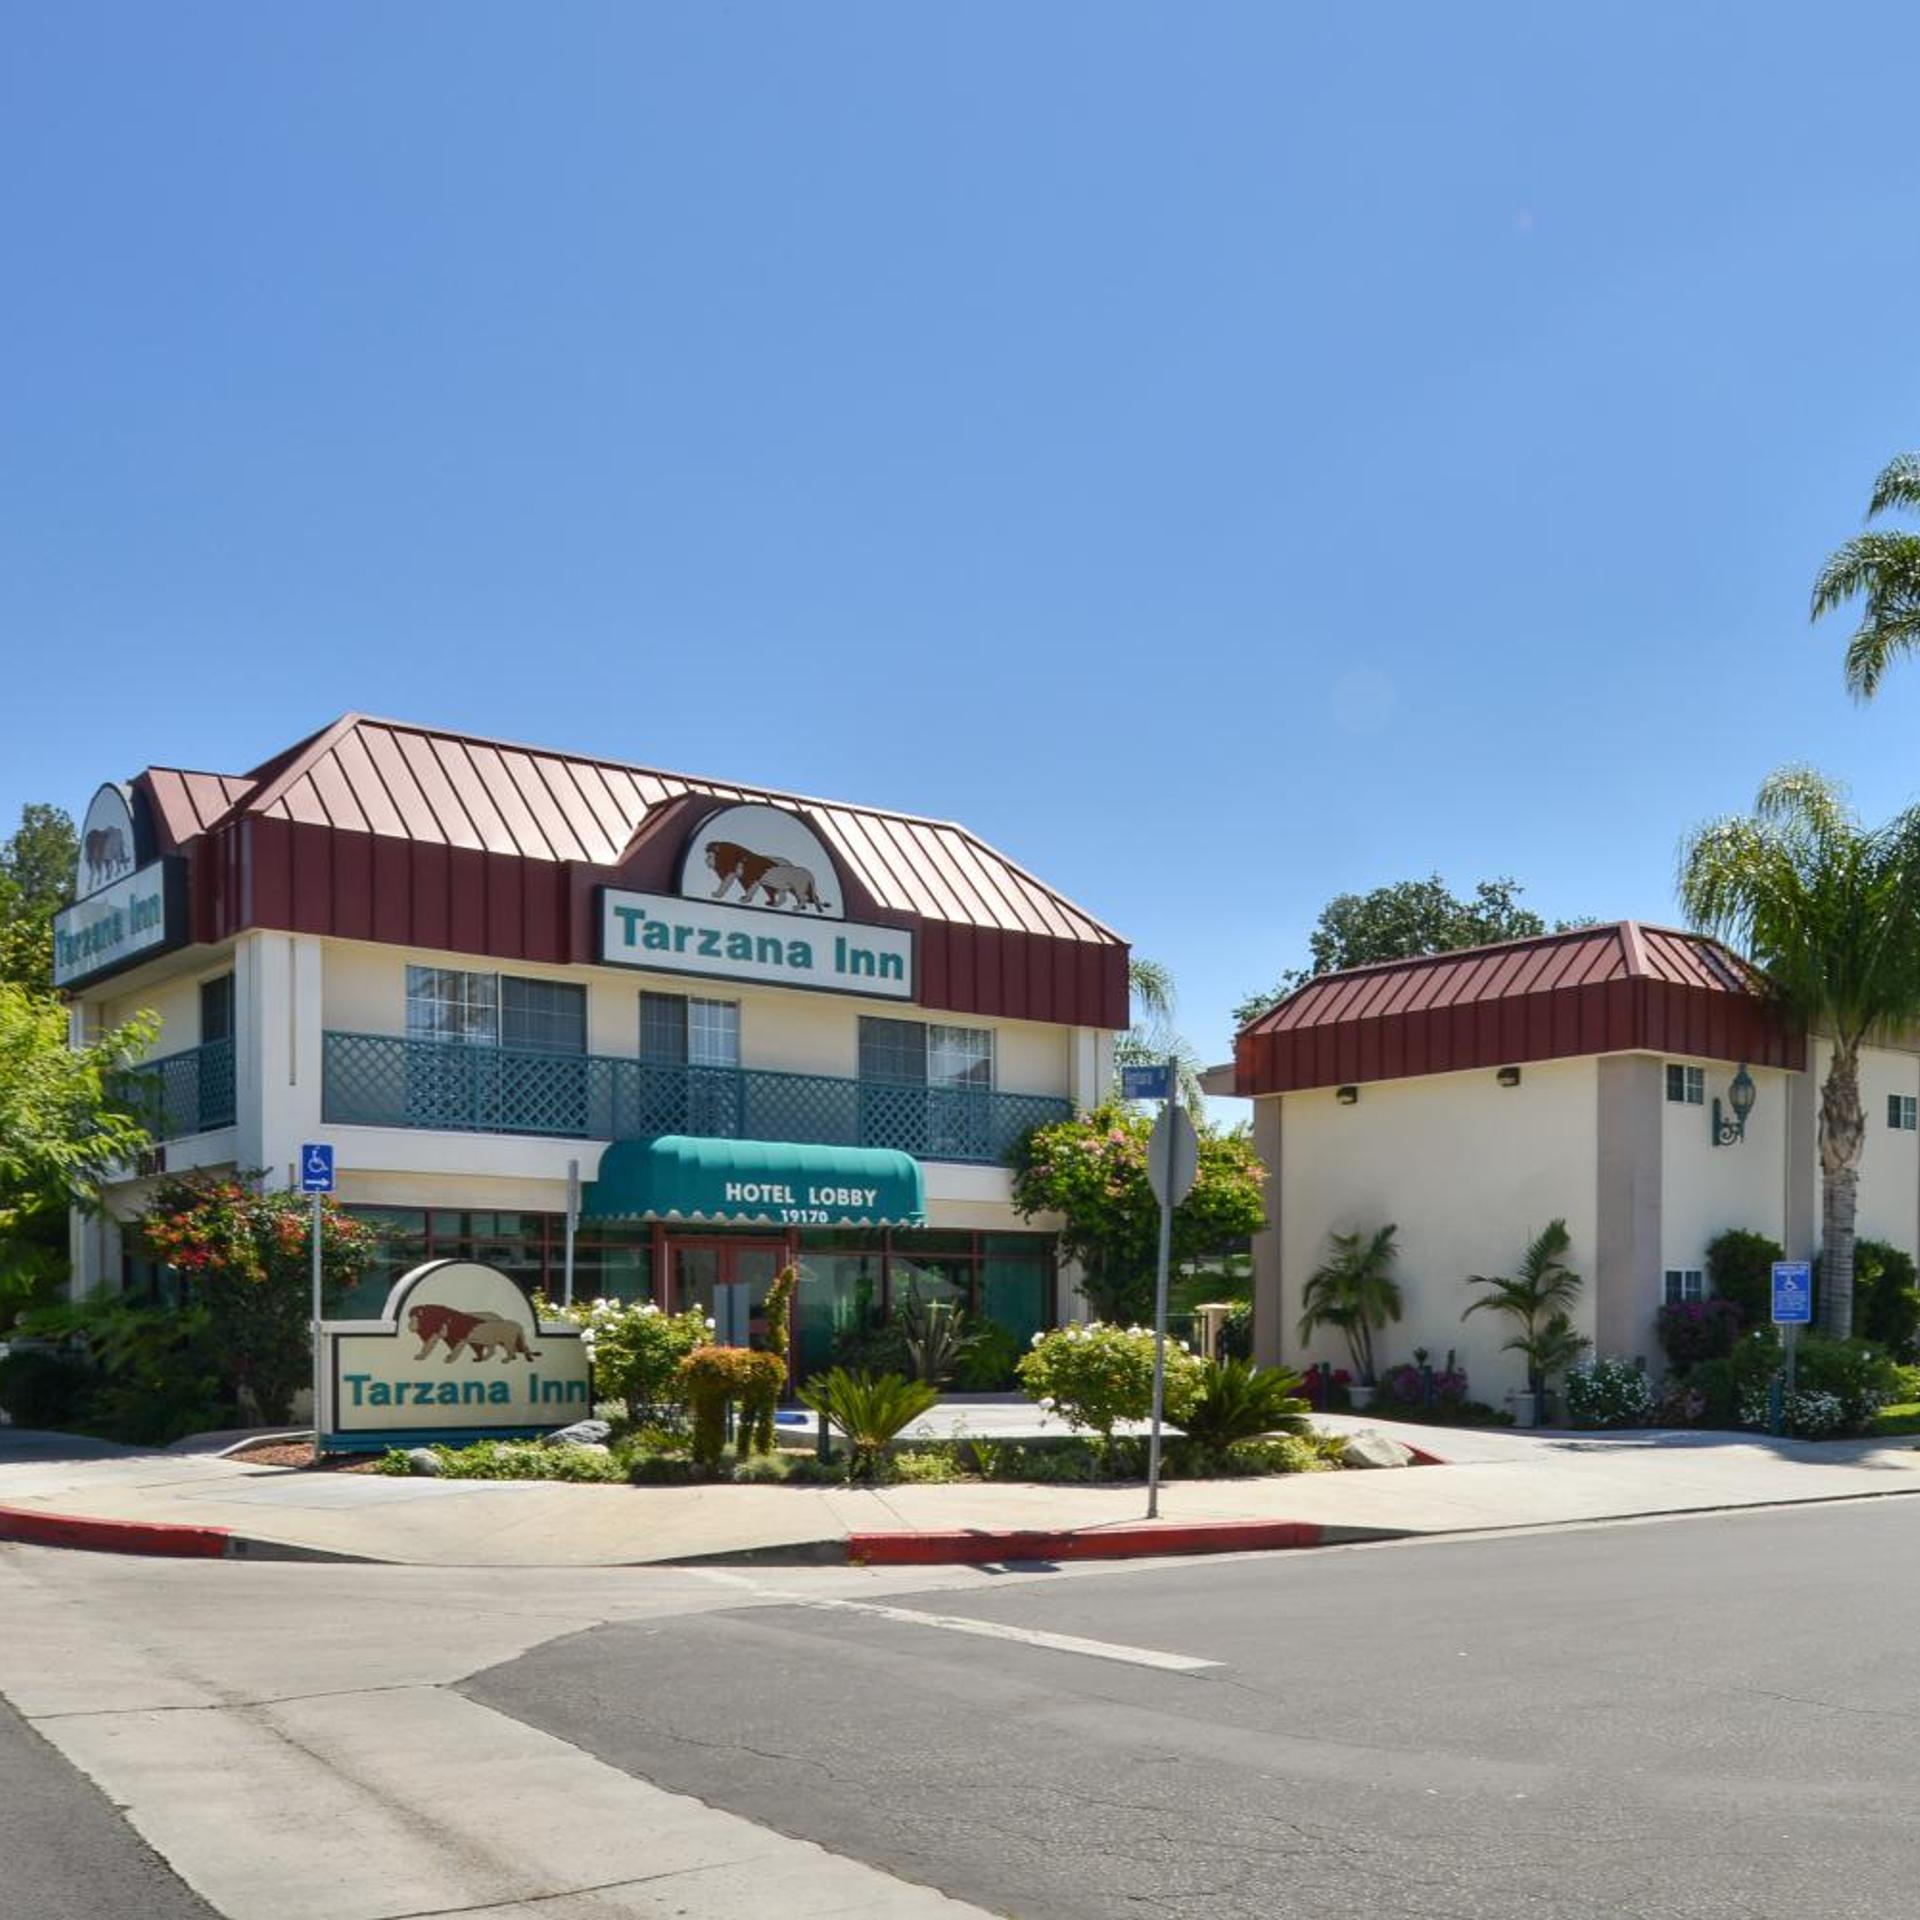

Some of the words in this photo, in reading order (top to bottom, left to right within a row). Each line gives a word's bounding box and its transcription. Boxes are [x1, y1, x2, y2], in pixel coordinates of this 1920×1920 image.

[613, 905, 813, 969] Tarzana
[835, 936, 904, 980] Inn
[725, 1182, 796, 1204] HOTEL
[809, 1187, 877, 1207] LOBBY
[781, 1209, 829, 1223] 19170
[343, 1374, 511, 1406] Tarzana
[529, 1373, 587, 1404] Inn
